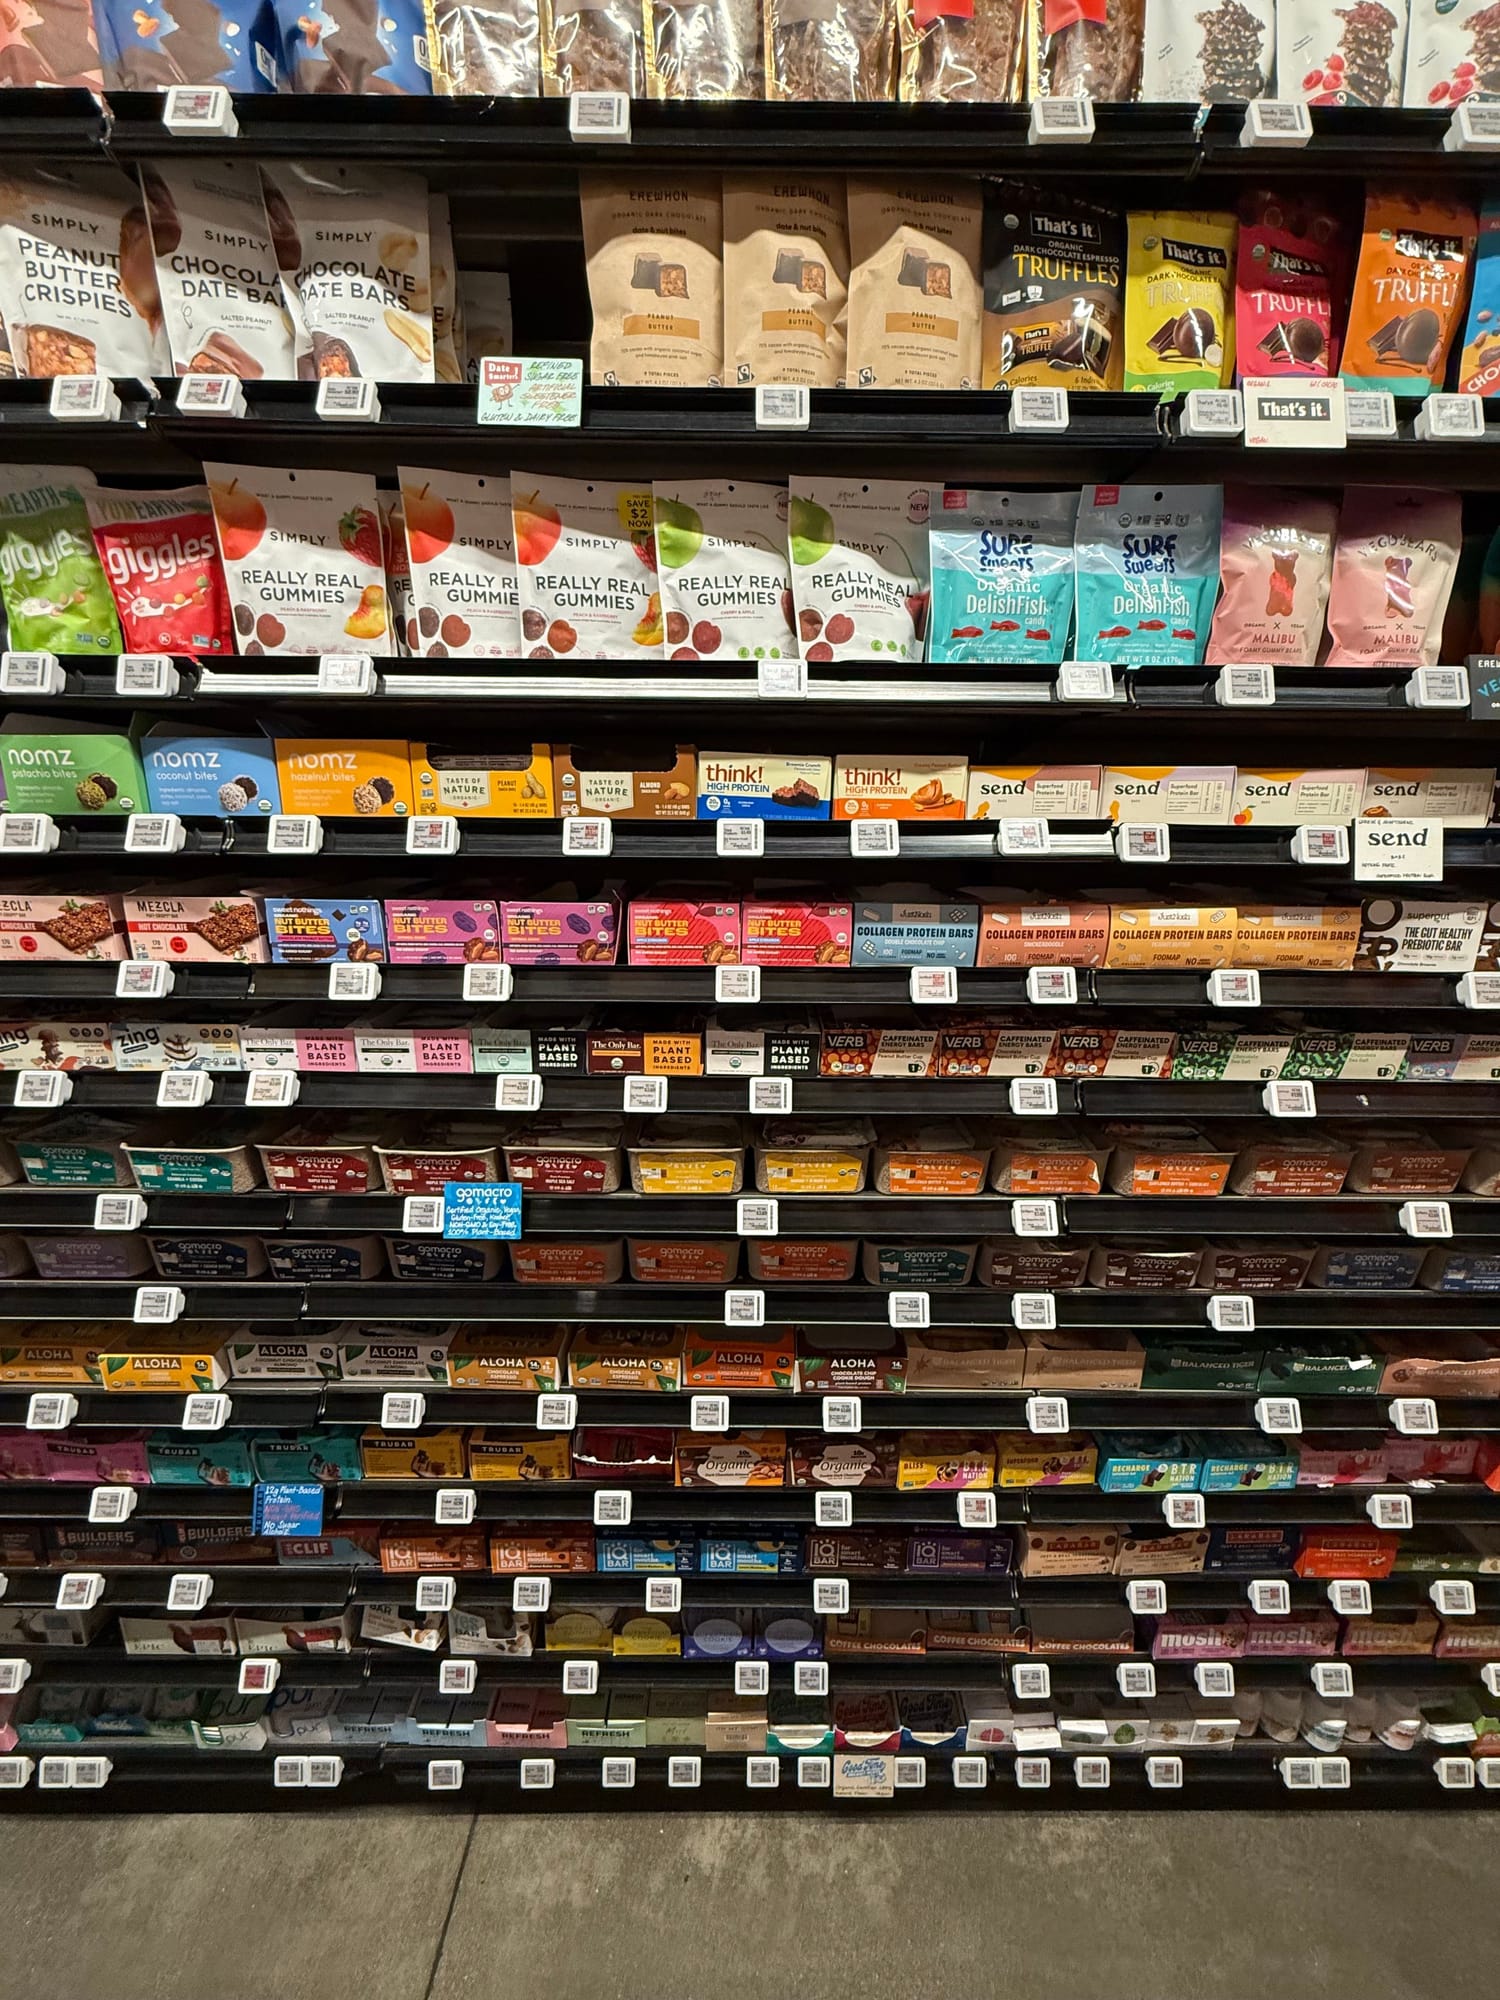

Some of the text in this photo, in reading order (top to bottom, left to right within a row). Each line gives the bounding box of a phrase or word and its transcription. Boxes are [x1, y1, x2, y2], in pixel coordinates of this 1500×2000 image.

[629, 190, 688, 202] EREWHON
[31, 213, 99, 234] SIMPLY
[1034, 217, 1078, 236] That's
[204, 230, 268, 253] SIMPLY
[315, 230, 373, 243] SIMPLY
[1048, 241, 1083, 252] ORGANIC
[18, 238, 121, 270] PEANUT
[1013, 244, 1120, 264] DARK CHOCOLATE ESPRESSO
[1165, 242, 1204, 264] That's
[25, 260, 121, 292] BUTTER
[1012, 254, 1119, 287] TRUFFLES
[182, 280, 238, 299] DATE
[24, 283, 132, 319] CRISPIES
[350, 282, 411, 312] BARS
[647, 313, 674, 321] PEANUT
[648, 323, 674, 331] BUTTER
[488, 363, 510, 373] Date
[1009, 376, 1037, 386] Calories
[1261, 402, 1327, 417] That's it.
[626, 500, 650, 509] SAVE
[909, 502, 929, 512] NEW
[631, 508, 649, 521] $2
[627, 519, 652, 529] NOW
[270, 531, 326, 546] SIMPLY
[459, 537, 512, 551] SIMPLY
[566, 538, 618, 550] SIMPLY
[707, 538, 757, 549] SIMPLY
[838, 539, 887, 556] SIMPLY
[1123, 534, 1178, 559] SURF
[107, 532, 215, 585] giggles
[242, 570, 364, 590] REALLY REAL
[429, 572, 495, 588] REALLY
[679, 575, 744, 592] REALLY
[812, 573, 914, 598] REALLY REAL
[536, 576, 651, 598] REALLY REAL
[977, 579, 1041, 595] Organic
[259, 587, 345, 604] GUMMIES
[697, 591, 777, 607] GUMMIES
[831, 588, 902, 609] GUMMIES
[554, 593, 635, 611] GUMMIES
[966, 594, 1049, 616] DelishFish
[1113, 595, 1190, 616] DelishFish
[1025, 617, 1046, 626] candy
[1252, 634, 1296, 644] MALIBU
[1374, 635, 1419, 645] MALIBU
[8, 748, 75, 766] nomz
[153, 751, 220, 768] nomz
[288, 753, 357, 770] nomz
[12, 768, 77, 781] pistachio bites
[156, 771, 218, 781] coconut bites
[290, 771, 355, 782] hazelnut bites
[706, 764, 763, 784] think!
[845, 767, 902, 786] think!
[443, 786, 486, 796] NATURE
[639, 781, 661, 789] ALMOND
[706, 782, 769, 793] HIGH PROTEIN
[845, 785, 908, 795] HIGH PROTEIN
[980, 780, 1026, 796] send
[1114, 781, 1160, 796] send
[1245, 782, 1292, 797] send
[1374, 782, 1420, 797] send
[586, 787, 629, 797] NATURE
[1368, 828, 1428, 847] send
[137, 900, 185, 913] MEZCLA
[295, 918, 330, 926] BUTTER
[393, 917, 447, 926] NUT BUTTER
[634, 918, 688, 928] NUT BUTTER
[1407, 912, 1450, 923] supergut
[138, 922, 188, 931] HOT CHOCOLATE
[275, 925, 331, 935] BITES
[393, 925, 449, 934] BITES
[635, 927, 689, 936] BITES
[857, 927, 974, 939] COLLAGEN PROTEIN BARS
[986, 929, 1104, 940] COLLAGEN PROTEIN BARS
[1405, 927, 1473, 940] THE GUT HEALTHY
[1401, 939, 1463, 951] PREBIOTIC BAR
[120, 1029, 160, 1046] zing
[827, 1034, 865, 1048] VERB
[882, 1035, 934, 1043] CAFFEINATED
[1355, 1038, 1407, 1047] CAFFEINATED
[306, 1042, 345, 1051] PLANT
[592, 1040, 606, 1049] The
[607, 1040, 626, 1050] Only
[653, 1045, 691, 1054] PLANT
[1300, 1040, 1337, 1052] VERB
[307, 1052, 346, 1061] BASED
[653, 1054, 692, 1064] BASED
[296, 1156, 343, 1168] gomacro
[536, 1156, 582, 1168] gomacro
[456, 1188, 512, 1203] gomacro
[905, 1250, 948, 1262] gomacro
[260, 1345, 307, 1357] ALOHA
[133, 1358, 181, 1370] ALOHA
[480, 1358, 524, 1369] ALOHA
[831, 1358, 876, 1369] ALOHA
[1182, 1360, 1255, 1369] BALANCED TIGER
[374, 1441, 413, 1449] TRUBAR
[705, 1459, 751, 1472] Organic
[820, 1460, 867, 1472] Organic
[1112, 1465, 1150, 1474] RECHARGE
[963, 1472, 988, 1480] NATION
[265, 1486, 278, 1496] 12g
[264, 1521, 275, 1529] No
[67, 1530, 134, 1544] BUILDERS
[292, 1542, 329, 1555] CLIF
[390, 1547, 411, 1559] IQ
[391, 1559, 413, 1568] BAR
[934, 1635, 1026, 1648] COFFEE CHOCOLATES
[1161, 1630, 1221, 1648] mosh
[1252, 1627, 1312, 1646] mosh
[344, 1725, 392, 1734] REFRESH
[422, 1728, 470, 1738] REFRESH
[582, 1729, 630, 1739] REFRESH
